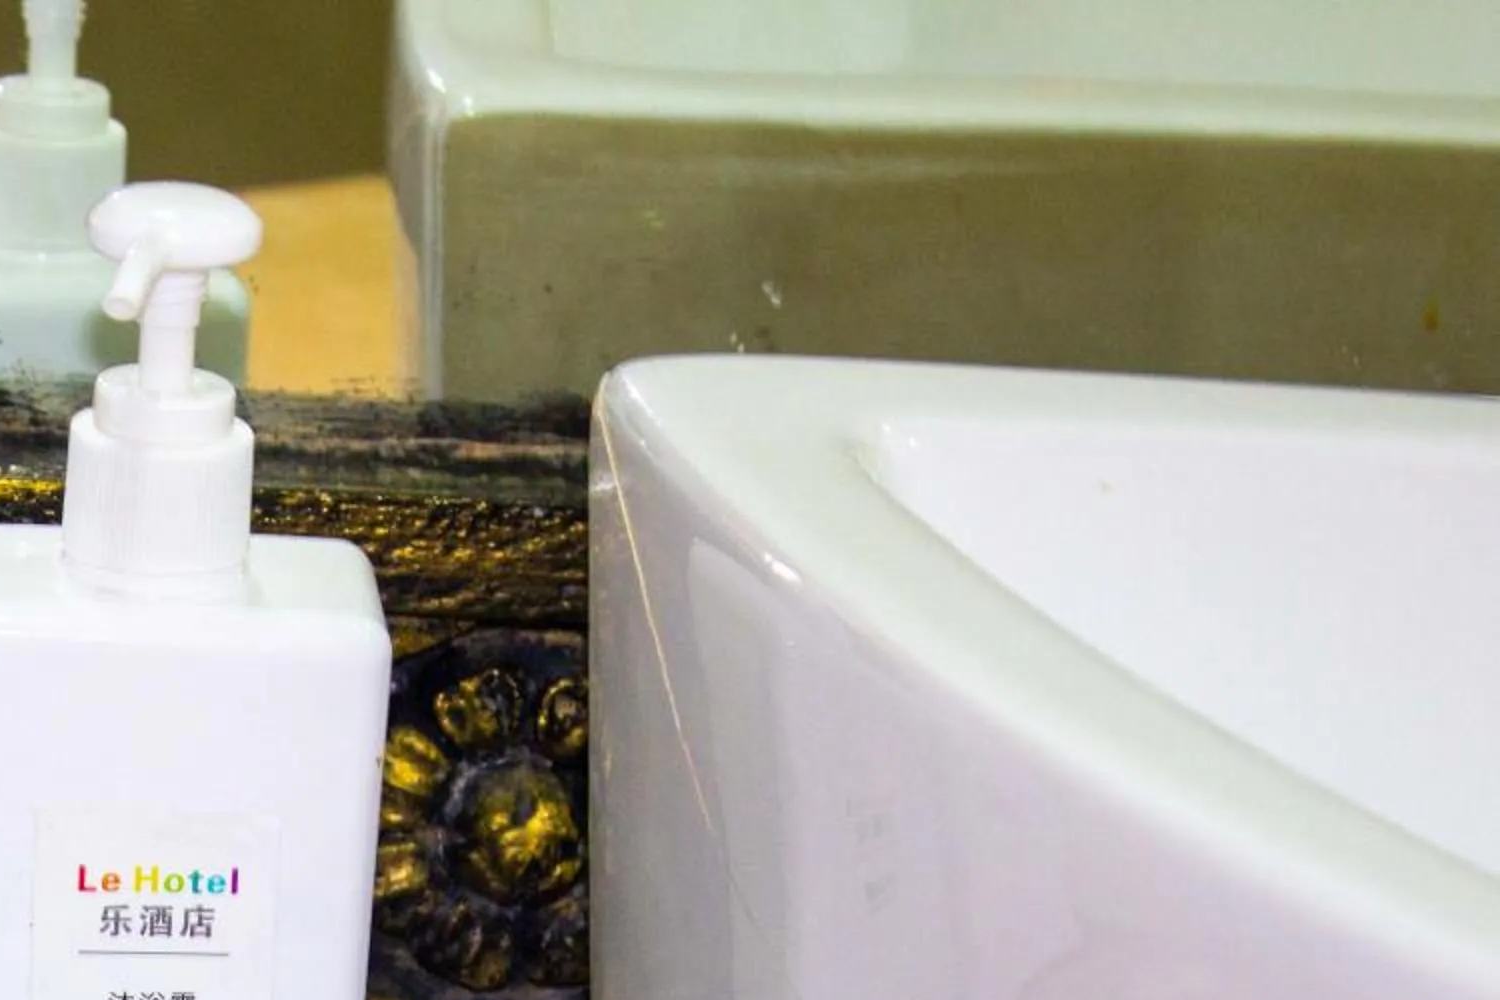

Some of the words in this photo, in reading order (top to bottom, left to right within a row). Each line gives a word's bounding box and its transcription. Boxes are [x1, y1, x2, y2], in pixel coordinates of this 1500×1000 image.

[77, 863, 122, 893] Le
[133, 864, 240, 895] Hotel
[99, 904, 216, 939] 乐酒店
